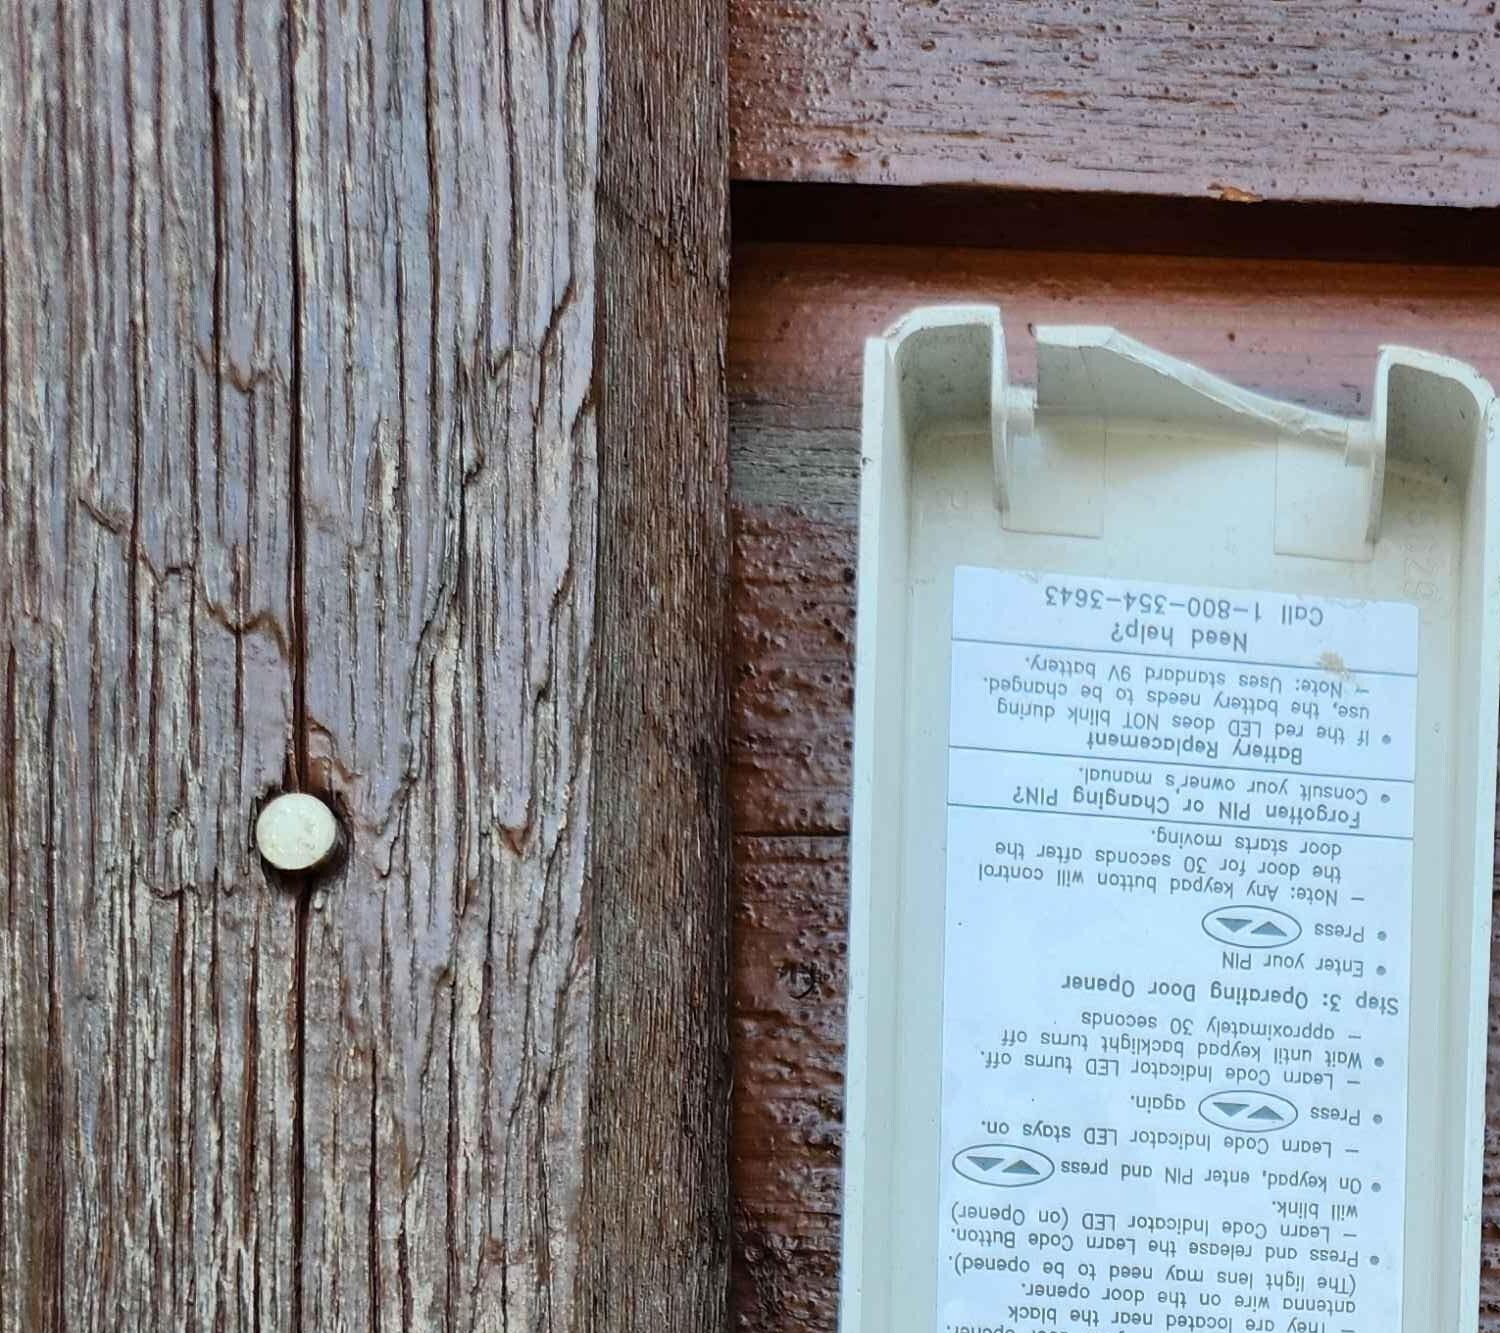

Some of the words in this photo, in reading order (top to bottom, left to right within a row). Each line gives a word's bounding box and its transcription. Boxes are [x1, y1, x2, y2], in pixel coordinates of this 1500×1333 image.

[1044, 585, 1263, 624] 1-800-354-3643
[1281, 604, 1325, 628] Call
[1110, 617, 1175, 649] help?
[1191, 627, 1249, 655] Need
[1024, 653, 1097, 681] battery.
[1107, 664, 1133, 683] 9V
[1144, 666, 1227, 690] standard
[1238, 673, 1283, 695] Uses
[1295, 678, 1343, 699] Note:
[997, 696, 1057, 724] during
[1067, 706, 1112, 728] blink
[1122, 711, 1160, 732] NOT
[1171, 714, 1217, 736] does
[1227, 719, 1263, 740] LED
[1274, 722, 1305, 741] red
[1086, 731, 1220, 760] Replacement
[1316, 725, 1346, 746] the
[1356, 729, 1370, 748] If
[1232, 737, 1304, 767] Battery
[1078, 767, 1153, 786] manual.
[1165, 773, 1237, 796] owner's
[1246, 777, 1290, 797] your
[1012, 785, 1059, 808] PIN?
[1072, 784, 1171, 816] Changing
[1181, 798, 1206, 814] or
[1299, 783, 1369, 807] Consult
[1218, 800, 1252, 822] PIN
[1265, 803, 1361, 831] Forgotten
[978, 863, 1045, 884] control
[1056, 869, 1085, 889] will
[1097, 871, 1158, 895] button
[1169, 875, 1235, 901] keypad
[1246, 879, 1280, 903] Any
[1290, 886, 1339, 908] Note:
[1060, 973, 1136, 999] Opener
[1147, 980, 1197, 1004] Door
[1209, 980, 1310, 1011] Operating
[1322, 992, 1343, 1014] 3:
[1355, 989, 1400, 1017] Step
[1080, 1010, 1159, 1031] seconds
[1169, 1016, 1195, 1037] 30
[1206, 1015, 1336, 1042] approximately
[1000, 1028, 1029, 1048] off
[1040, 1031, 1089, 1053] turns
[1100, 1032, 1185, 1060] backlight
[1197, 1039, 1262, 1064] keypad
[1273, 1047, 1313, 1066] until
[1324, 1049, 1364, 1071] Wait
[1131, 1093, 1186, 1114] again.
[1309, 1105, 1362, 1128] Press
[1060, 1157, 1110, 1177] press
[1120, 1163, 1154, 1183] and
[1164, 1166, 1194, 1186] PIN
[1203, 1168, 1251, 1188] enter
[1261, 1169, 1328, 1194] keypad,
[1339, 1176, 1363, 1196] On
[950, 1227, 1017, 1250] Button.
[1027, 1232, 1075, 1253] Code
[1086, 1234, 1137, 1257] Learn
[1148, 1239, 1178, 1259] the
[1188, 1241, 1253, 1262] release
[1264, 1245, 1299, 1264] and
[1309, 1248, 1360, 1269] Press
[1007, 1305, 1058, 1327] black
[1069, 1308, 1101, 1328] the
[1110, 1311, 1154, 1327] near
[1245, 1318, 1276, 1333] are
